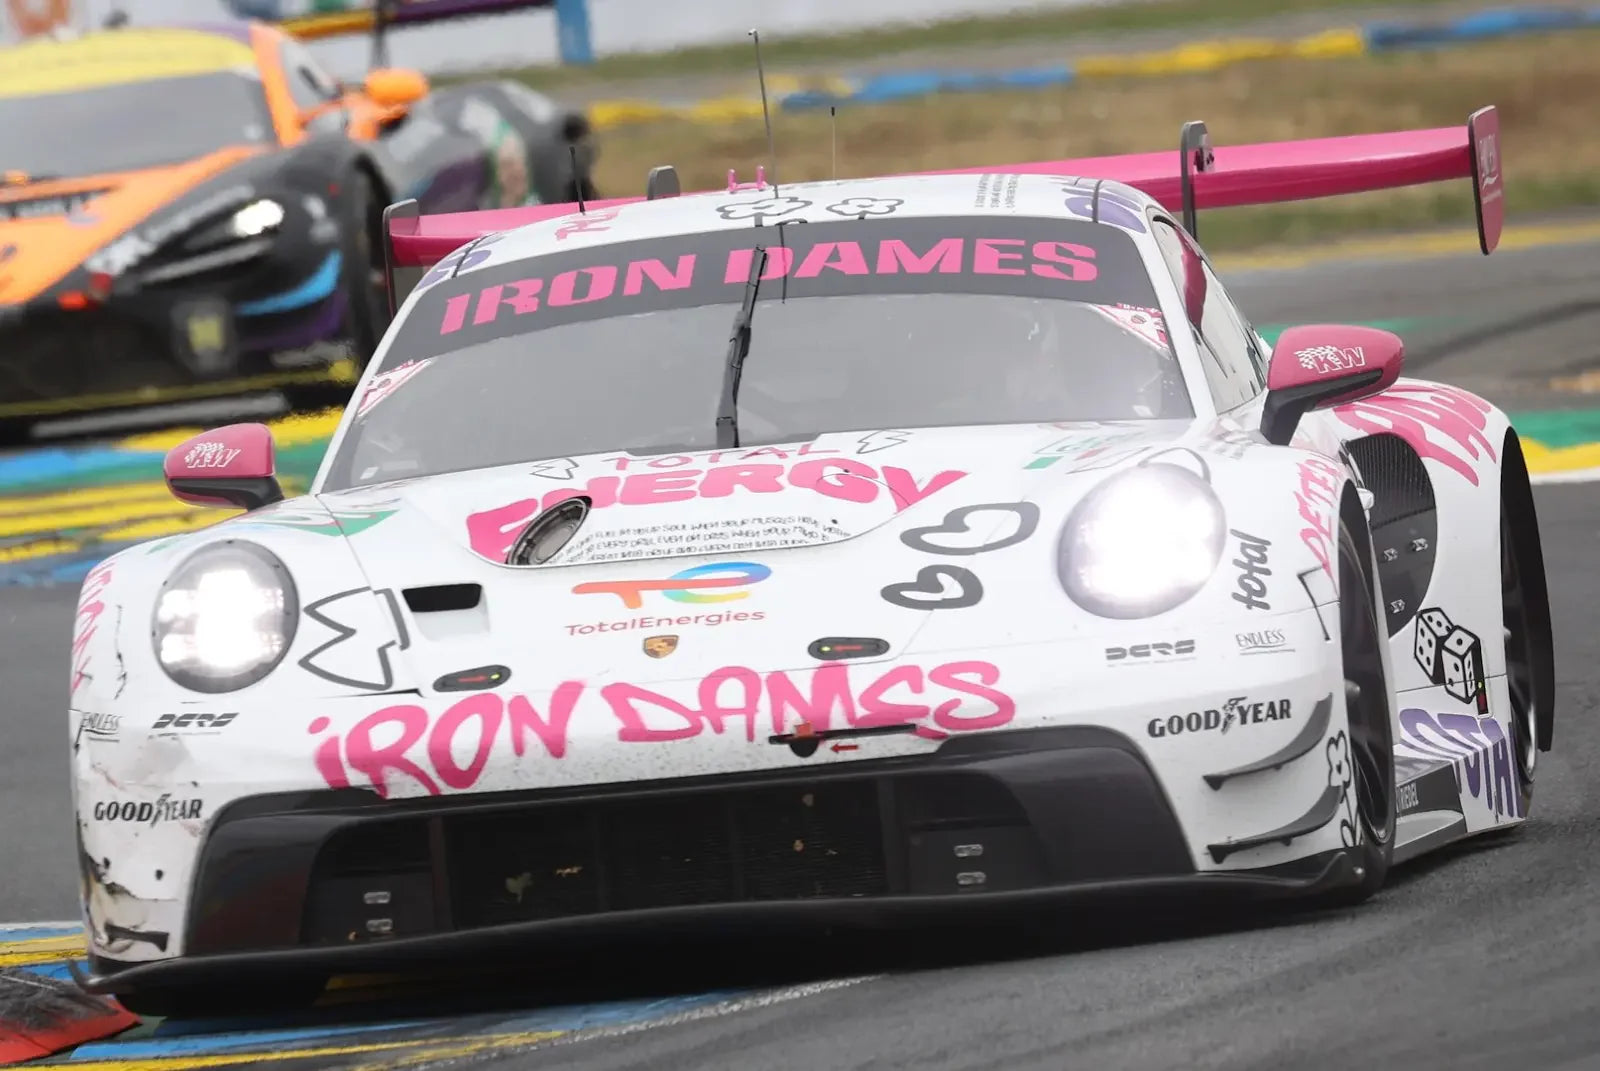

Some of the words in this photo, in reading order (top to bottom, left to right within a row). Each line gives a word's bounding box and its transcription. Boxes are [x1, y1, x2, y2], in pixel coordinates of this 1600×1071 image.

[440, 254, 698, 335] IRON
[724, 238, 1099, 283] DAMES
[602, 443, 841, 471] TOTAL
[466, 457, 971, 564] ENERGY
[565, 610, 766, 636] TotalEnergies
[600, 660, 1016, 744] DAMES
[1147, 697, 1292, 738] GOODYEAR
[94, 794, 202, 827] GOODYEAR
